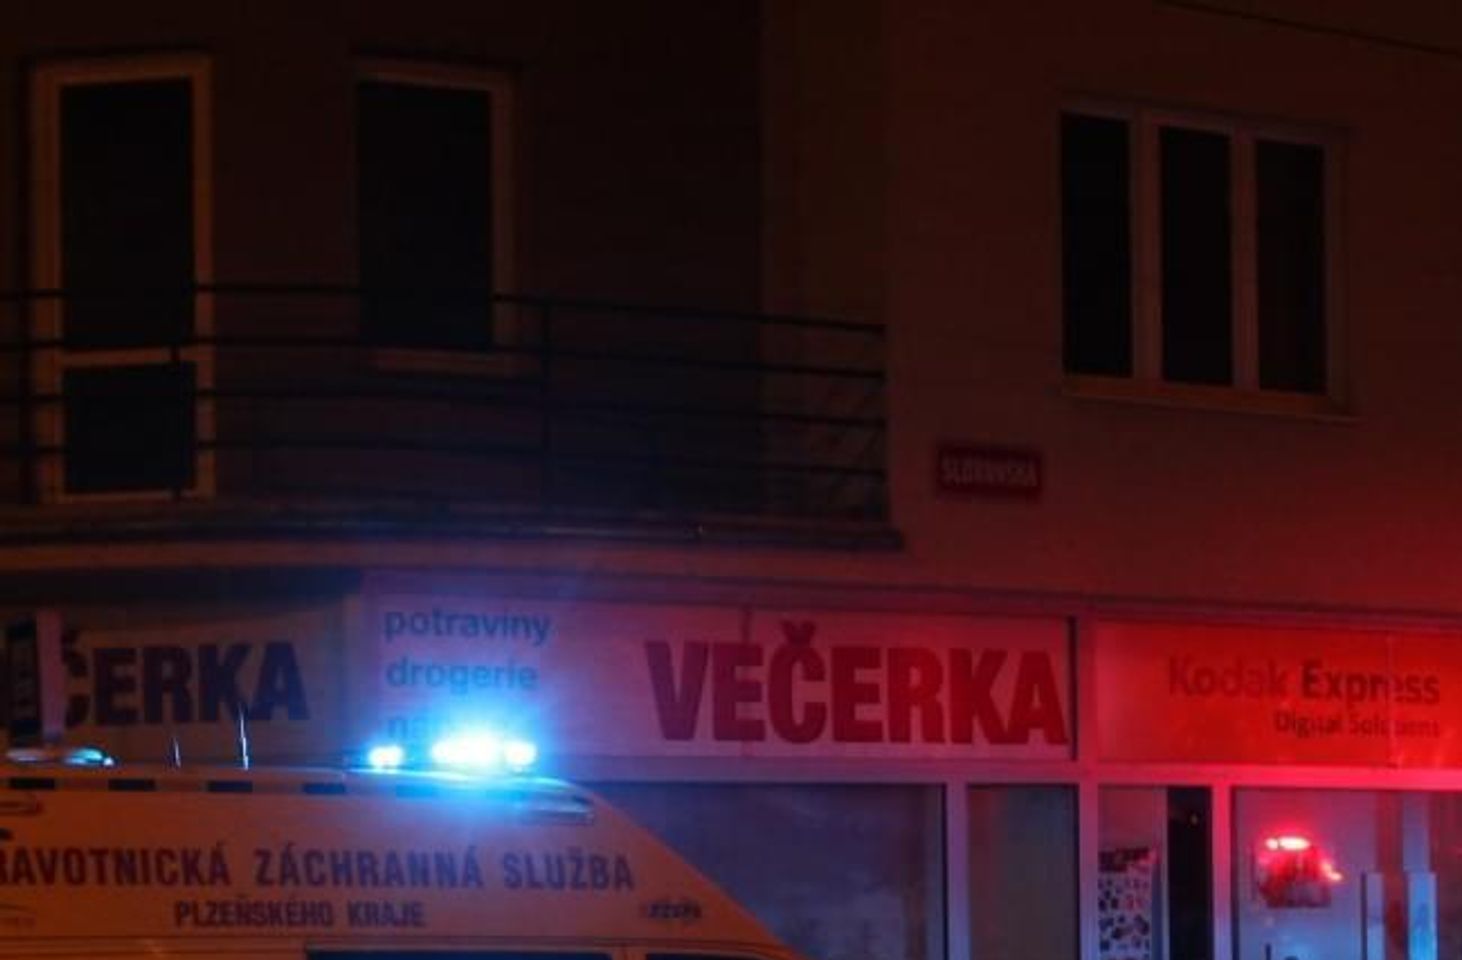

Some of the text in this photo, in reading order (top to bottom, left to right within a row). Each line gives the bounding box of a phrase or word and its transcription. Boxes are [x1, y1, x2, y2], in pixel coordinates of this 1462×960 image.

[384, 607, 551, 648] potraviny
[386, 656, 540, 694] drogerie
[644, 620, 1068, 744] VEČERKA
[1168, 655, 1288, 698] Kodak
[1274, 710, 1342, 738] Digital
[252, 842, 484, 888] ZÁCHRANNÁ
[503, 848, 634, 890] SLUŽBA
[347, 901, 426, 928] KRAJE
